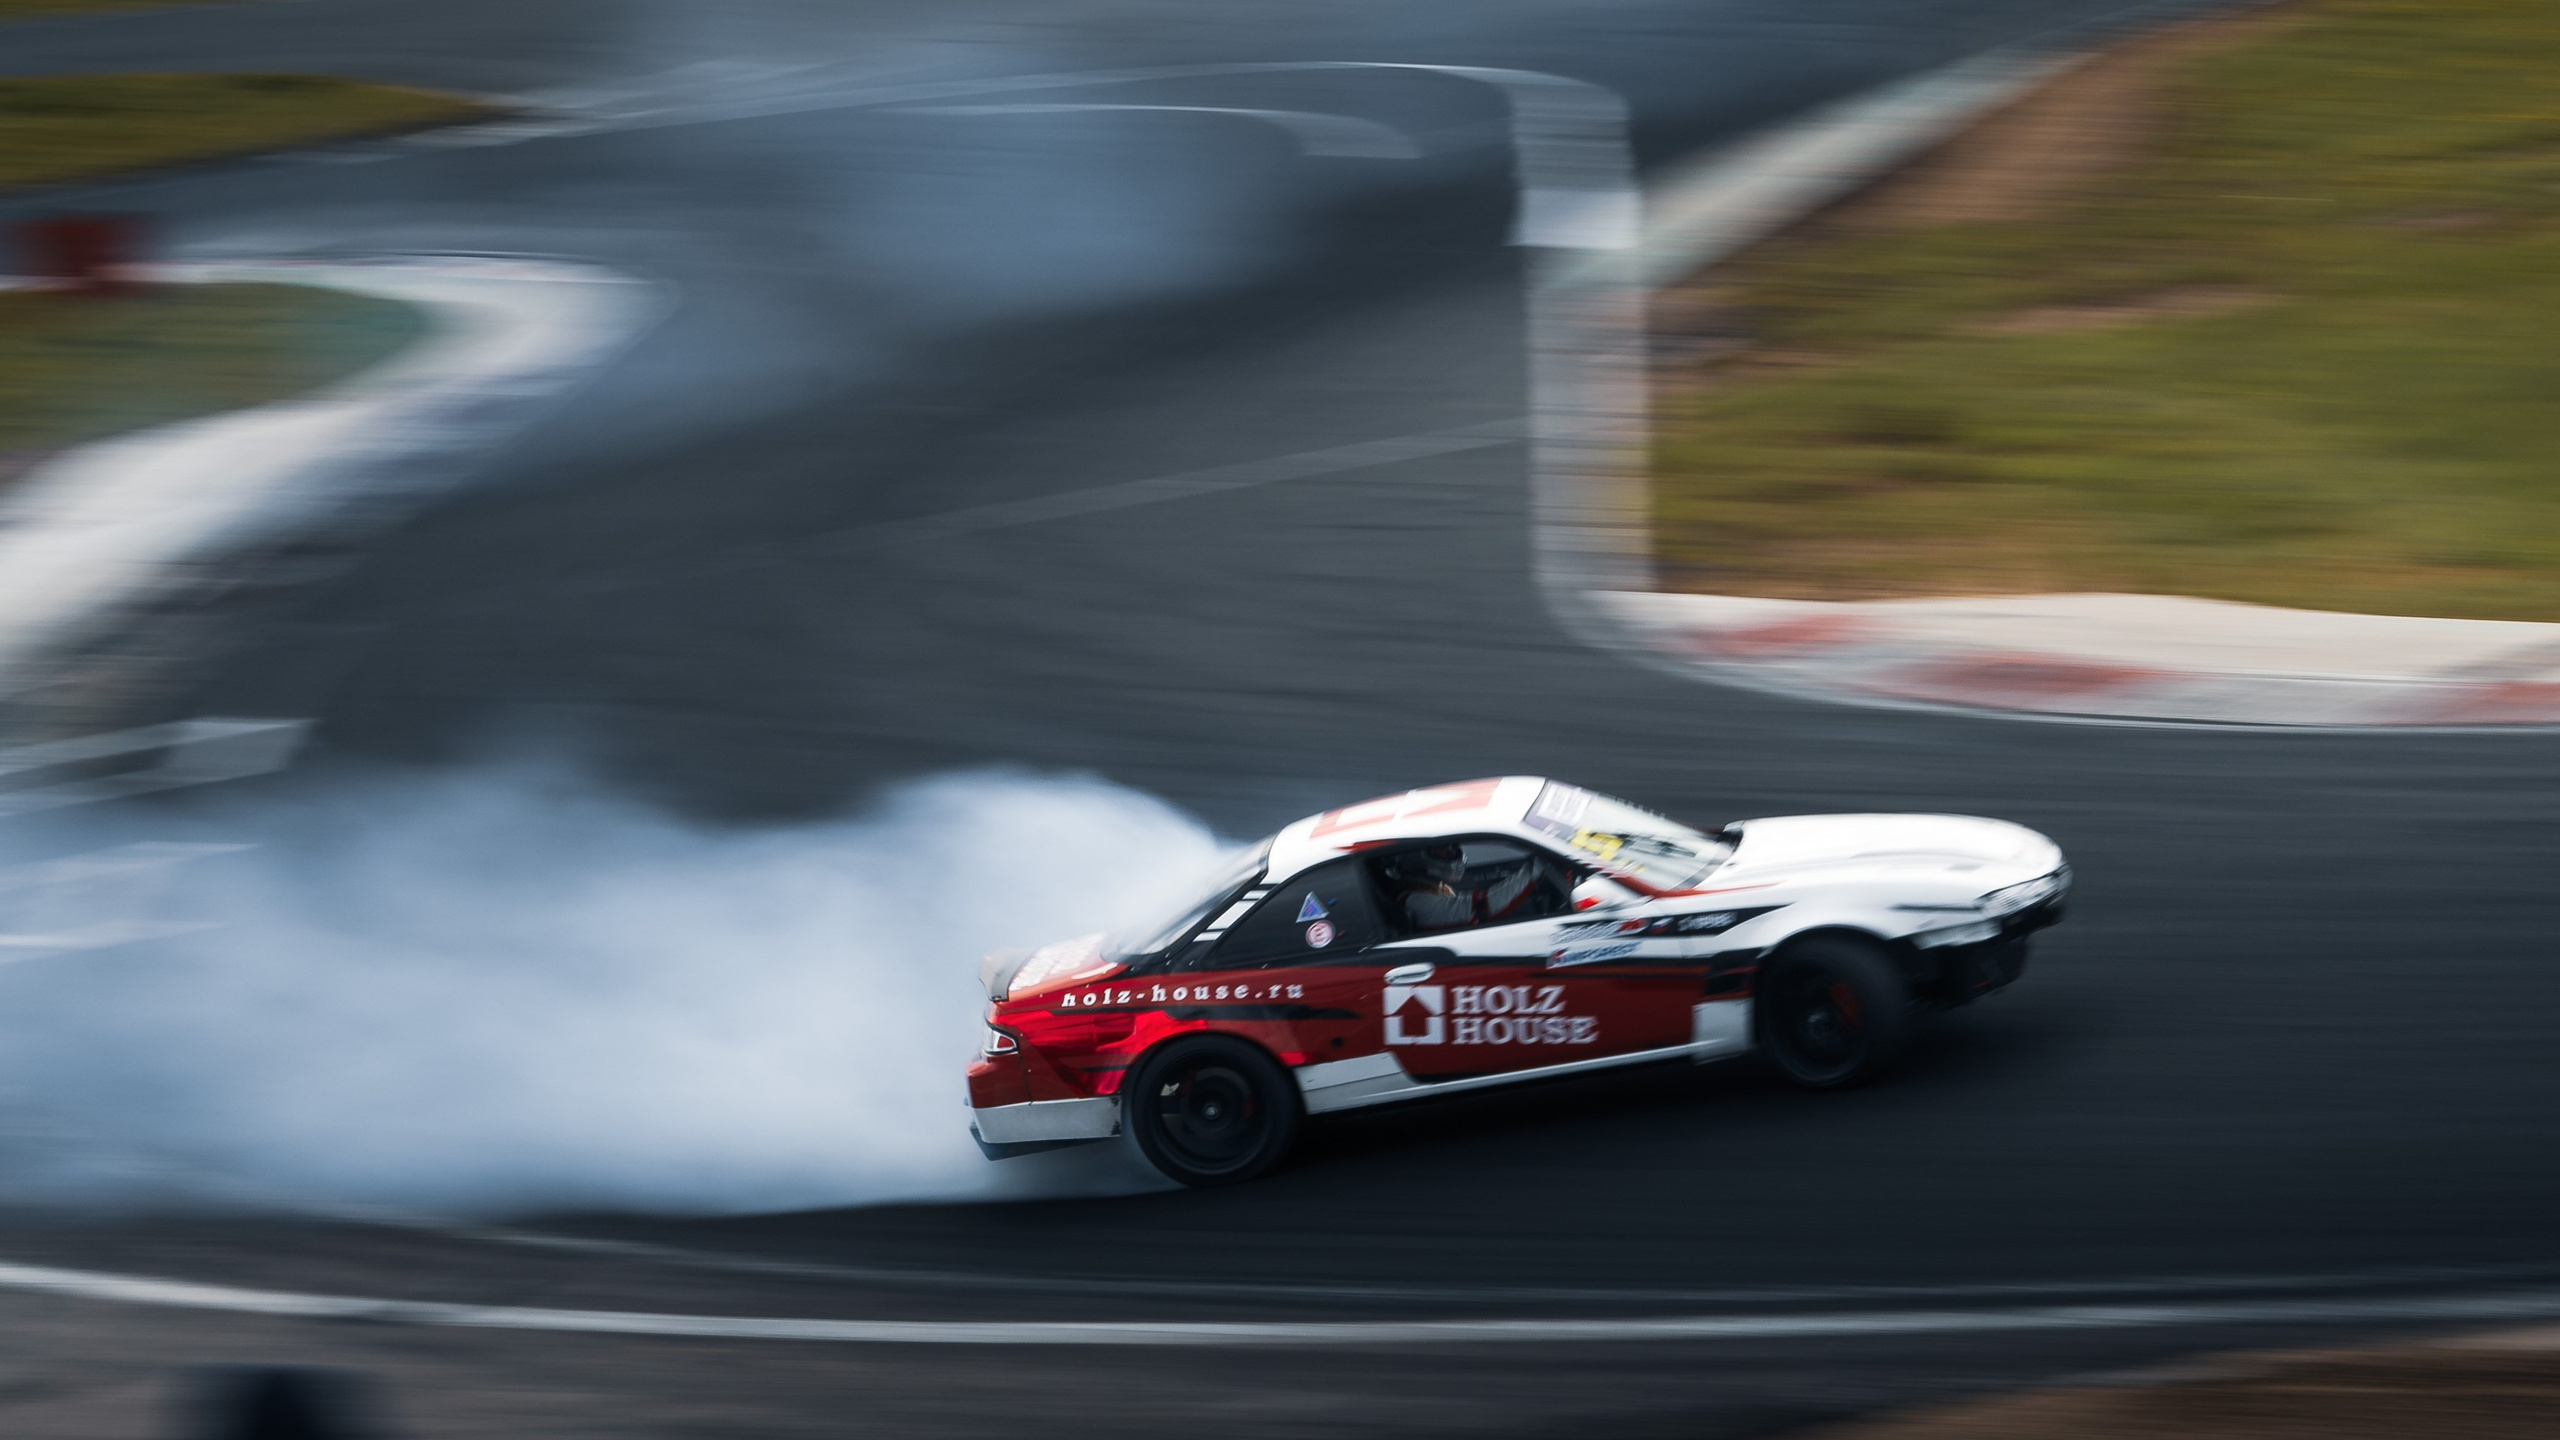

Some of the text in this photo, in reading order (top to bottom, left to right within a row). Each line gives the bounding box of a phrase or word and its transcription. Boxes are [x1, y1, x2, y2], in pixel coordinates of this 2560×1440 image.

[1061, 984, 1304, 1008] holz-house.ru
[1451, 984, 1566, 1015] HOLZ
[1451, 1016, 1599, 1045] HOUSE
